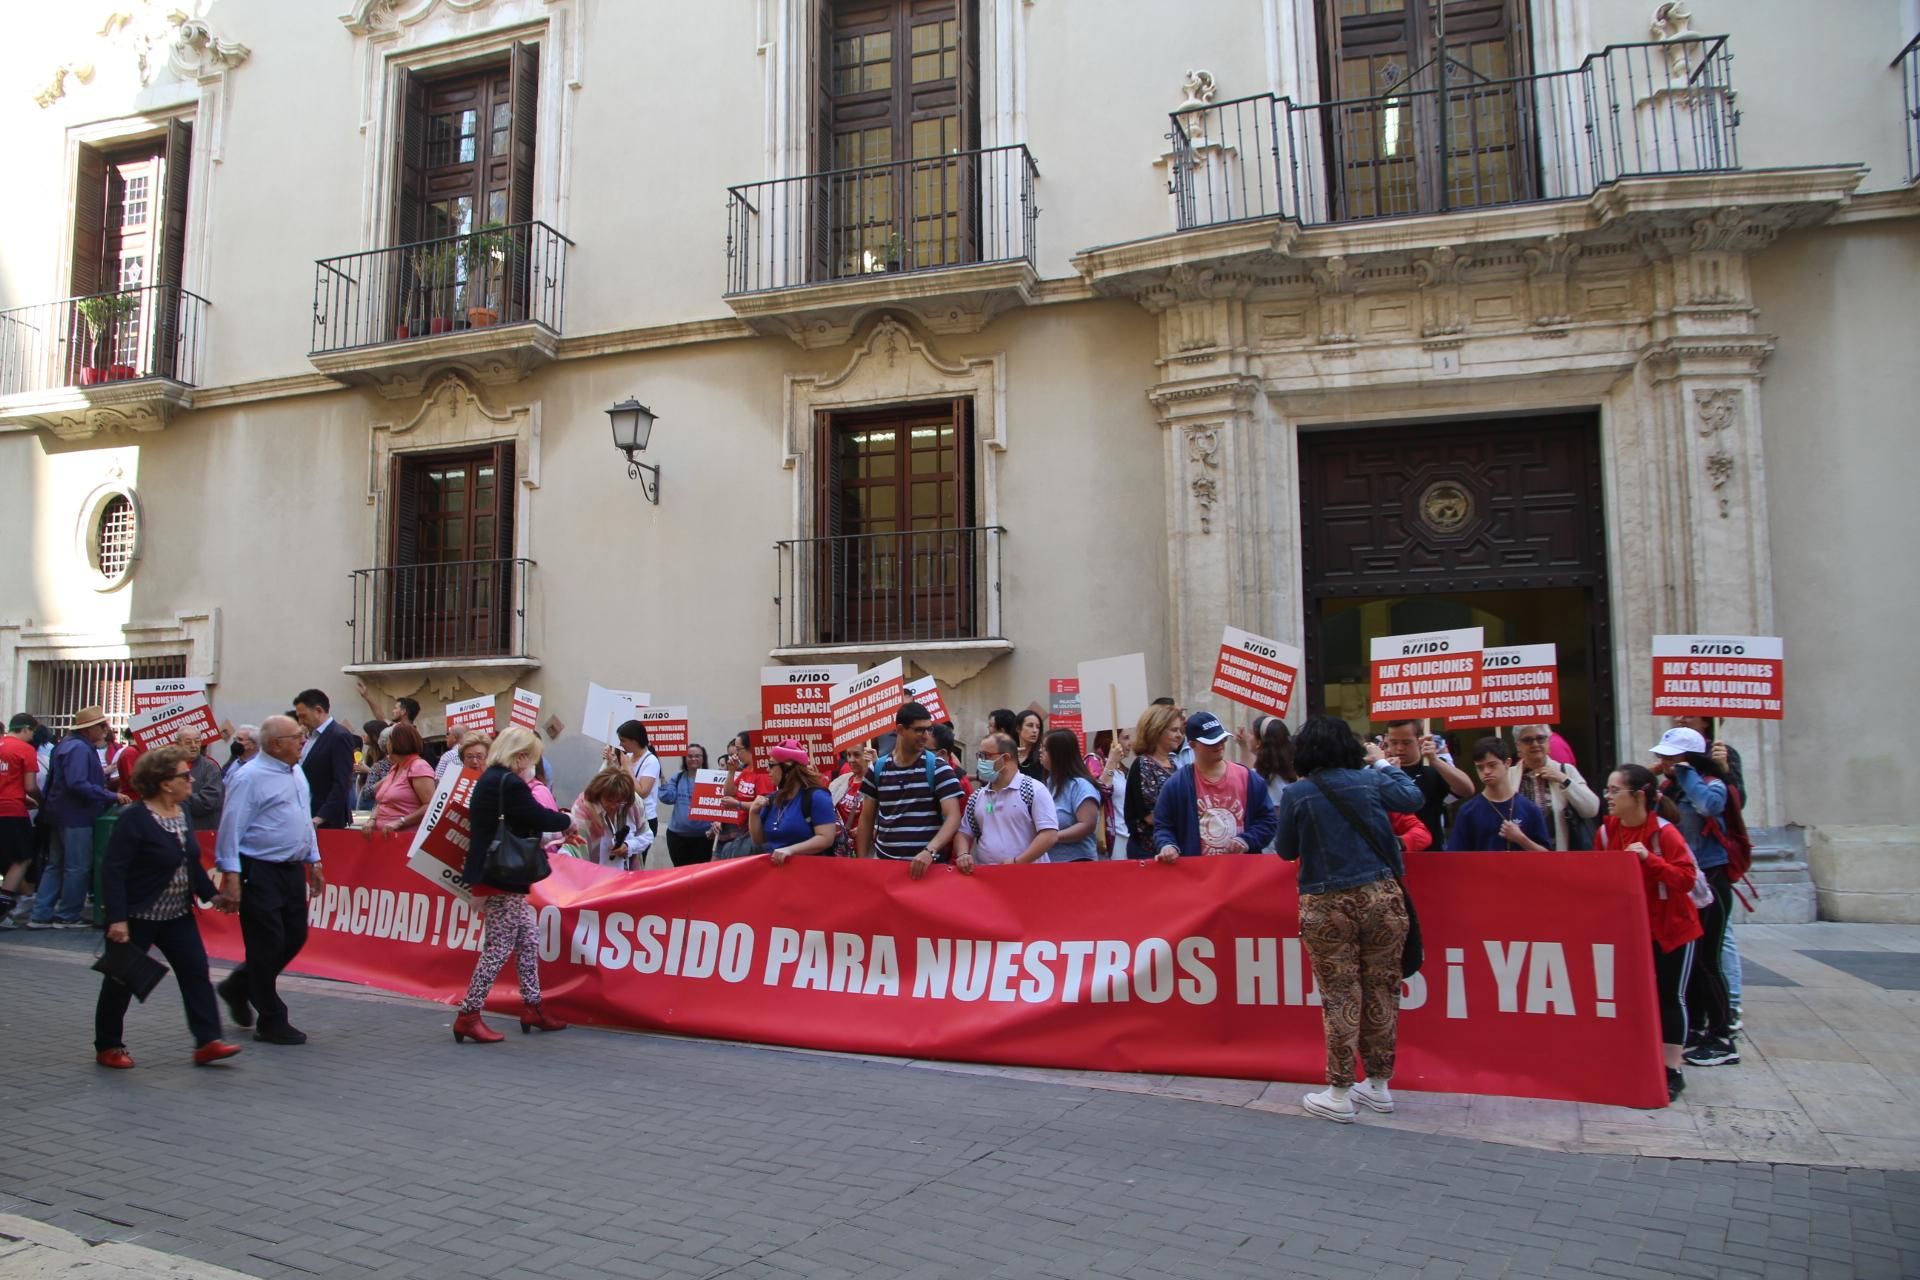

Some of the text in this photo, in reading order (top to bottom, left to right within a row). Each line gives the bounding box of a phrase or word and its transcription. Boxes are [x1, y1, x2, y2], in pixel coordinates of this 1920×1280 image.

[1222, 652, 1292, 682] NO QUEREMOS PRIVILEGIOS
[1379, 658, 1474, 678] HAY SOLUCIONES
[1663, 662, 1773, 678] HAY SOLUCIONES
[1221, 664, 1288, 696] TENEMOS DERECHOS
[1380, 678, 1472, 696] FALTA VOLUNTAD
[1664, 680, 1771, 695] FALTA VOLUNTAD
[796, 688, 823, 699] S.O.S.
[1252, 691, 1276, 707] ASSIDO
[1490, 688, 1548, 702] INCLUSIÓN
[834, 702, 859, 720] MURCIA
[859, 697, 868, 708] LO
[868, 684, 900, 704] NECESITA
[1372, 699, 1428, 713] ¡RESIDENCIA
[1428, 696, 1462, 708] ASSIDO
[1464, 694, 1480, 706] YA!
[1656, 697, 1780, 710] ¡RESIDENCIA ASSIDO YA!
[833, 714, 860, 731] NUESTROS
[860, 707, 876, 720] HIJOS
[877, 696, 902, 712] TAMBIÉN
[1496, 705, 1533, 718] ASSIDO
[1536, 704, 1552, 716] YA!
[140, 728, 156, 740] HAY
[156, 710, 206, 734] SOLUCIONES
[764, 718, 812, 729] ¡RESIDENCIA
[870, 716, 892, 731] ASSIDO
[656, 733, 684, 741] DERECHOS
[754, 746, 766, 756] DE
[570, 909, 754, 983] ASSIDO
[763, 926, 900, 996] PARA
[912, 936, 1218, 1005] NUESTROS
[1483, 940, 1576, 1016] YA
